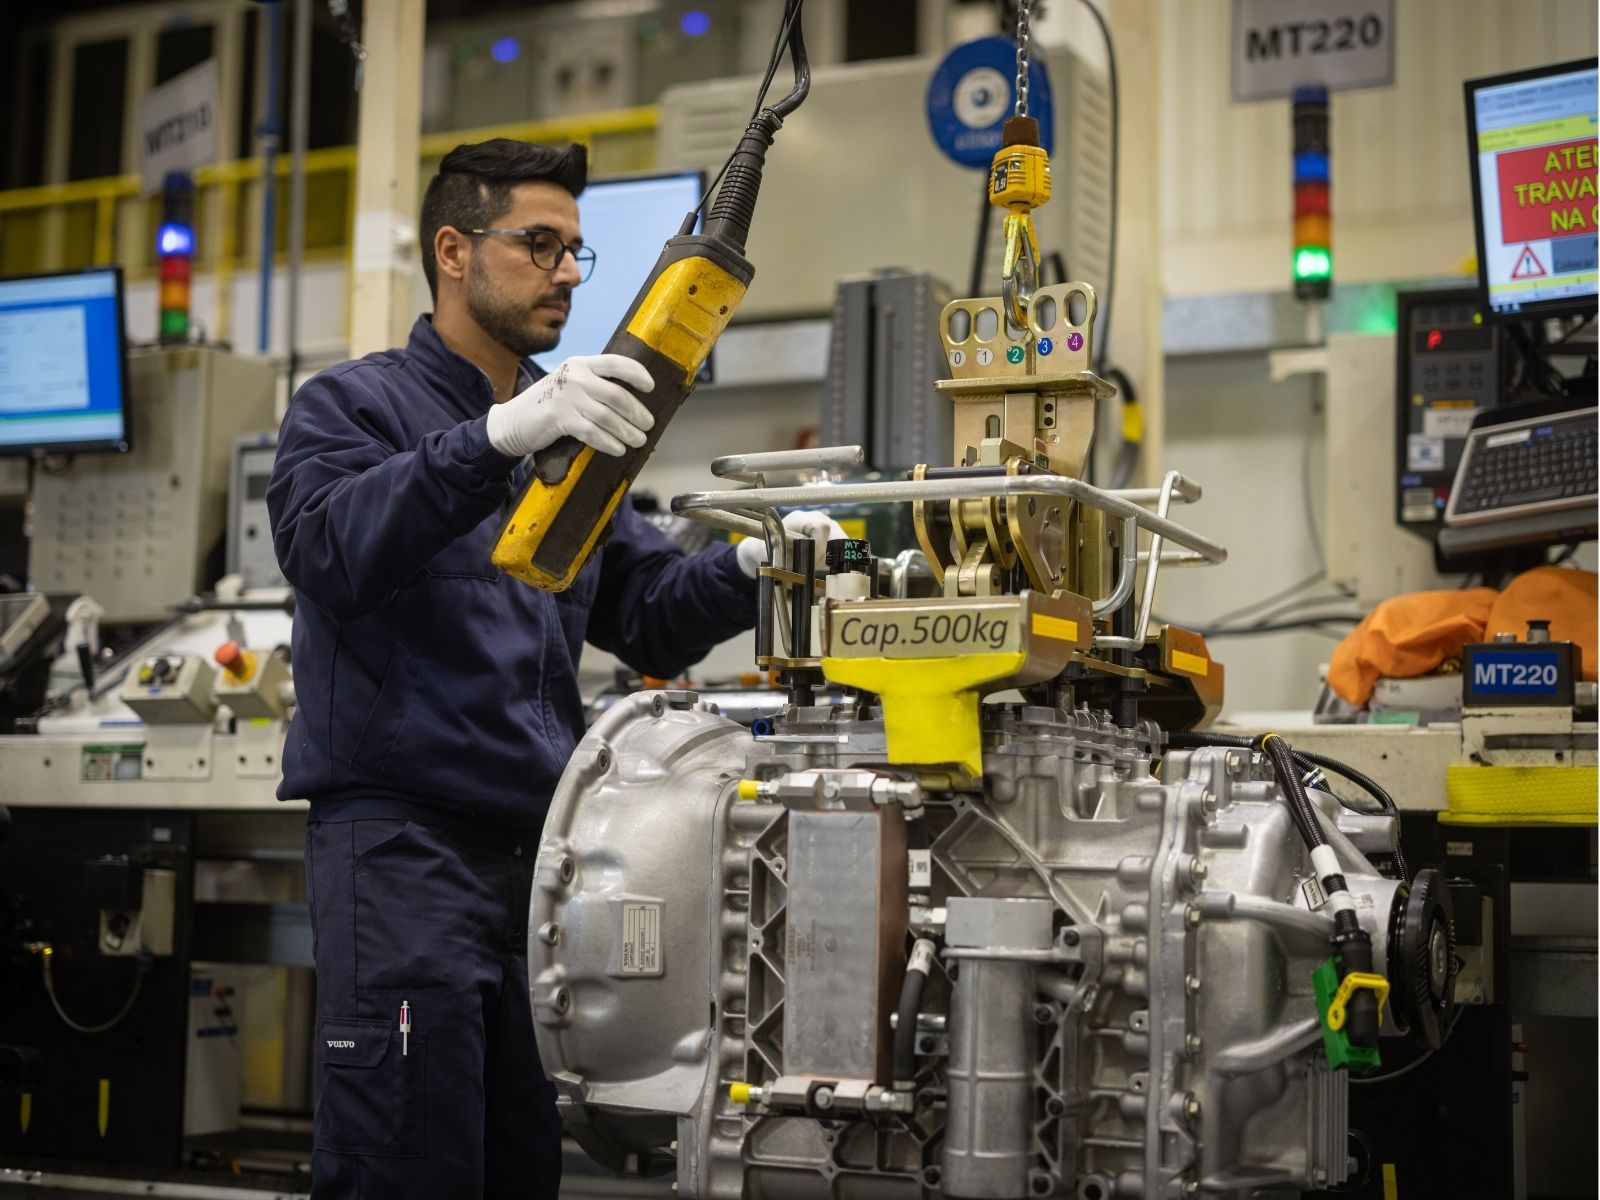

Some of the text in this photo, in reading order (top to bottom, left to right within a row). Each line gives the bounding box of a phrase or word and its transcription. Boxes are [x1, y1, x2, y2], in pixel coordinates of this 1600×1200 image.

[1246, 14, 1382, 61] MT220
[1513, 174, 1598, 208] TRAVA
[1551, 206, 1586, 232] NA
[1042, 341, 1049, 354] 3
[1072, 335, 1079, 348] 4
[954, 351, 961, 364] 0
[982, 351, 988, 363] 1
[1012, 349, 1019, 362] 2
[844, 541, 859, 549] MT
[844, 550, 862, 560] 220
[841, 612, 1008, 652] Cap.500kg
[1475, 663, 1558, 686] MT220
[326, 1040, 355, 1048] VOLVO
